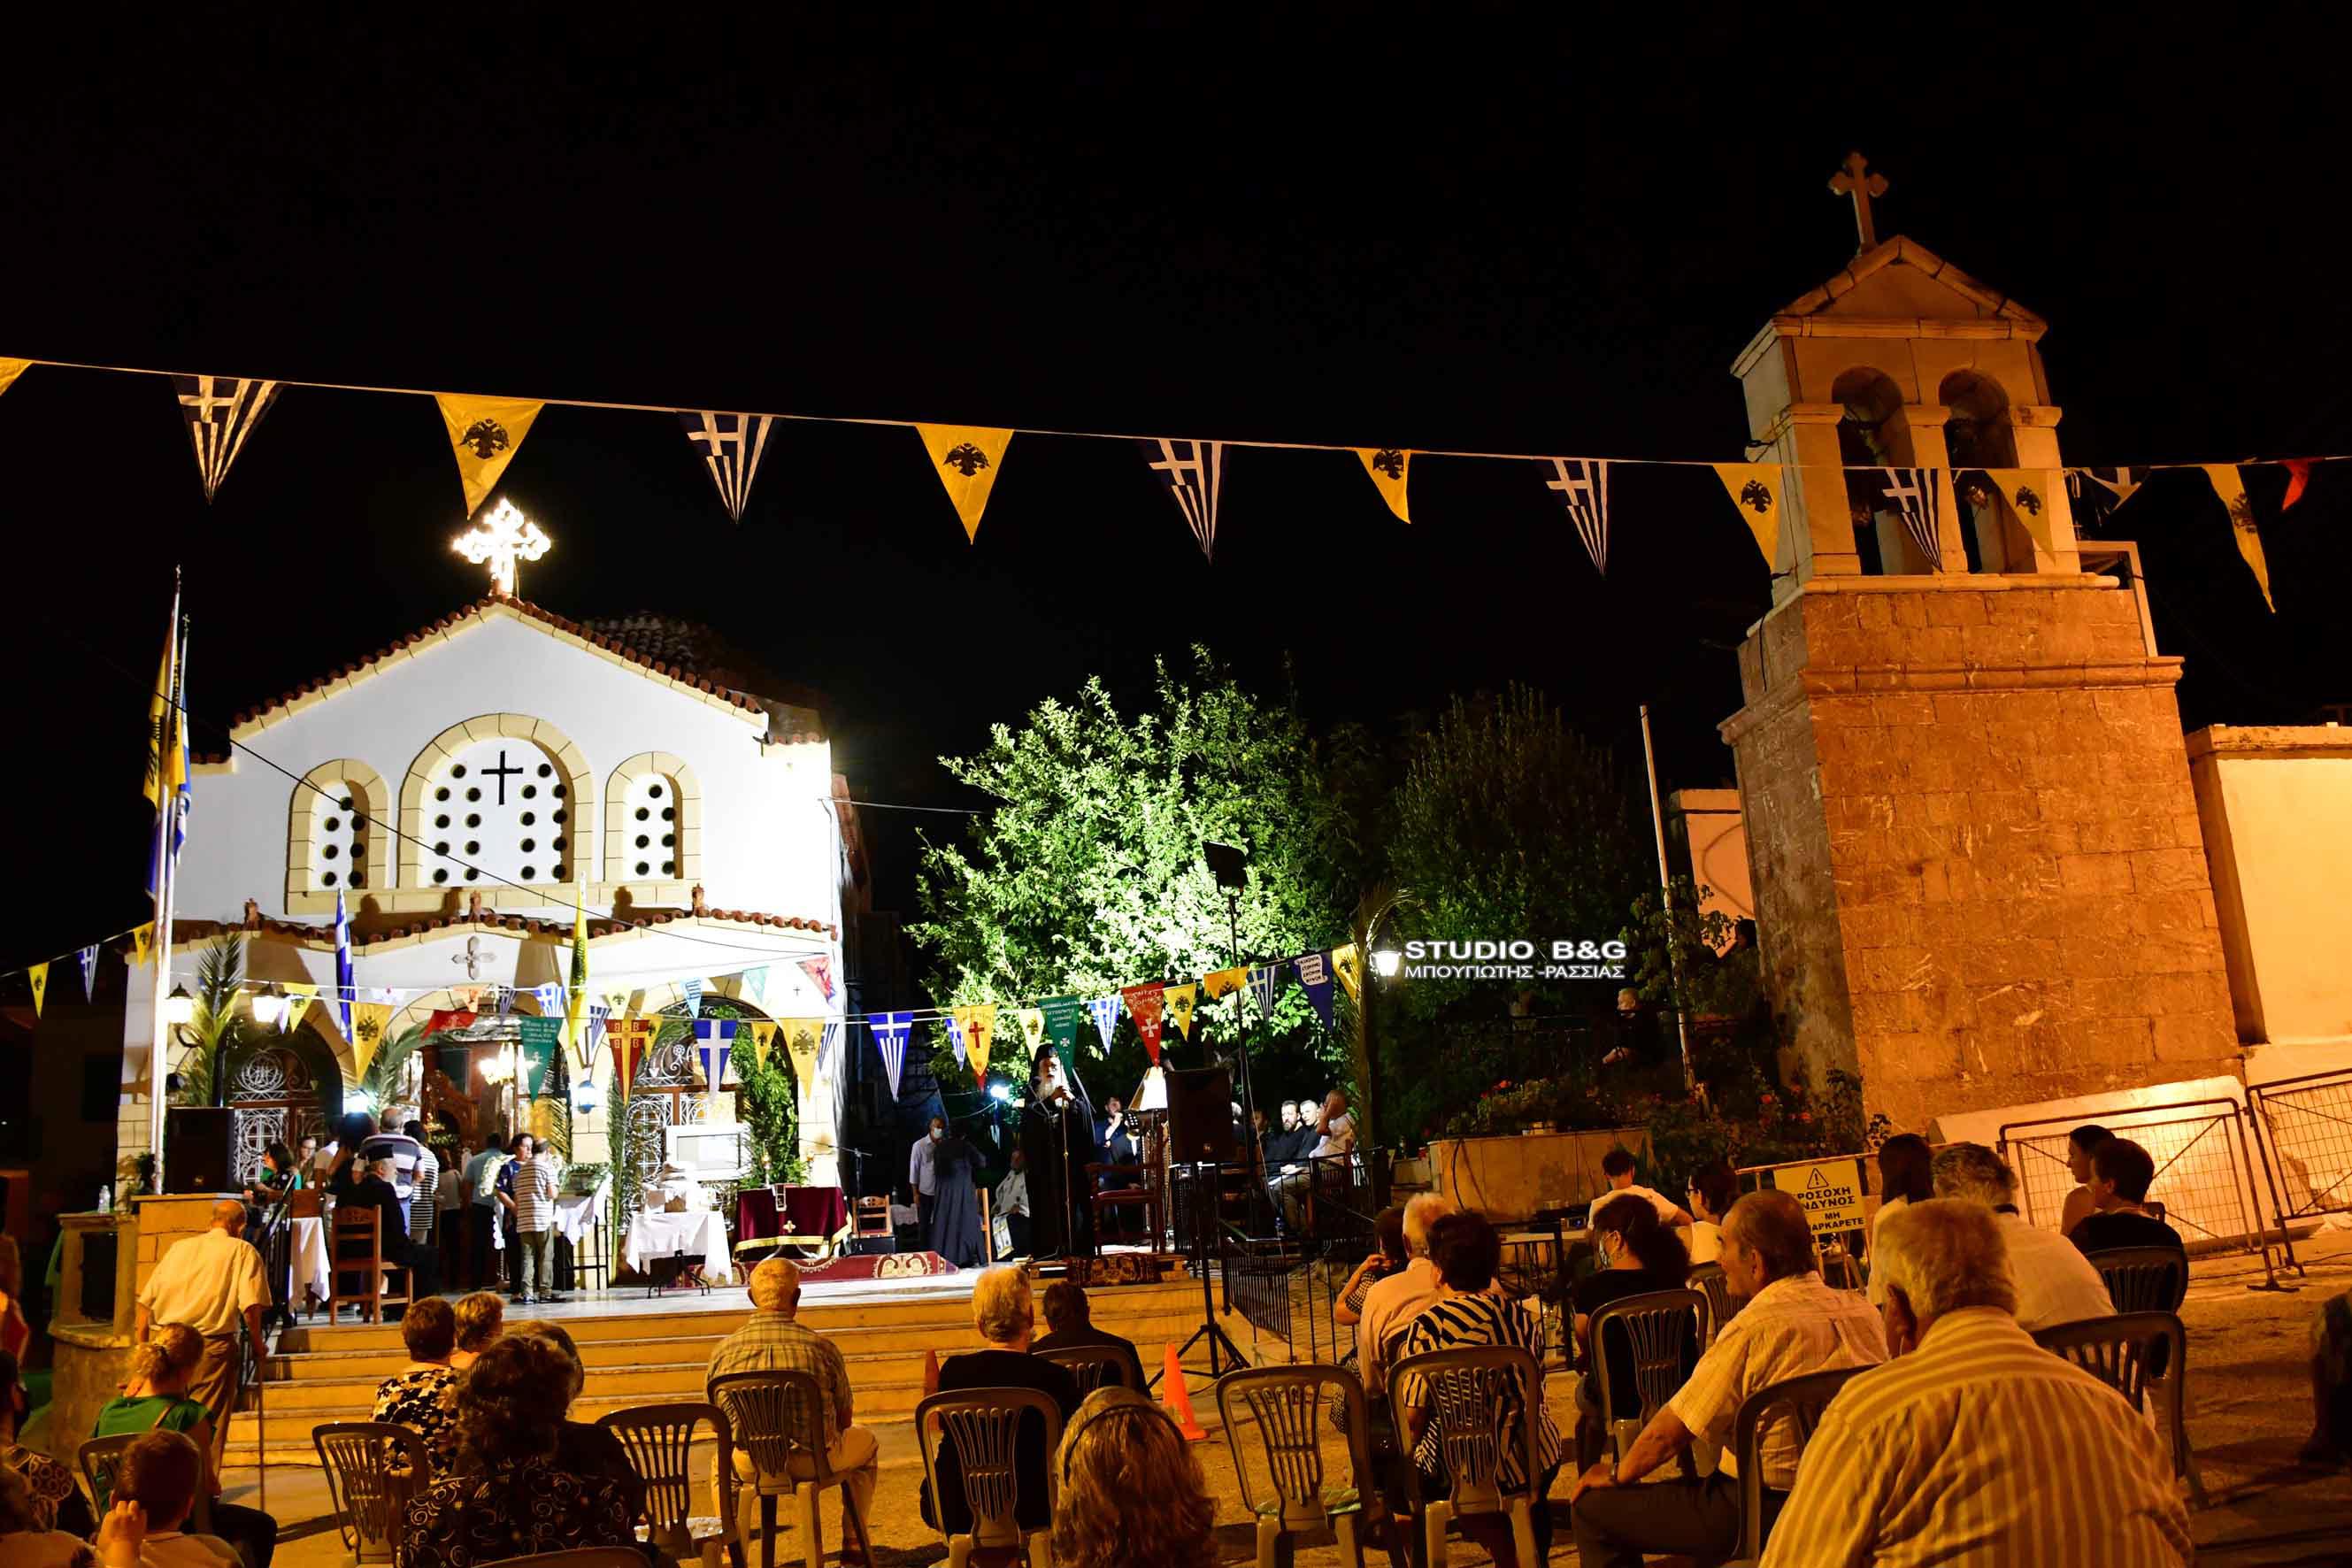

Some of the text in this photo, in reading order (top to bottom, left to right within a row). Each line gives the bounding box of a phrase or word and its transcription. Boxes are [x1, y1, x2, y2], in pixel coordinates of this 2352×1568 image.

[1797, 1187, 1850, 1200] ΡΟΣΟΧΗ
[1803, 1196, 1855, 1210] ΝΔΥΝΟΣ
[1811, 1218, 1864, 1231] ΑΡΚΑΡΕΤΕ
